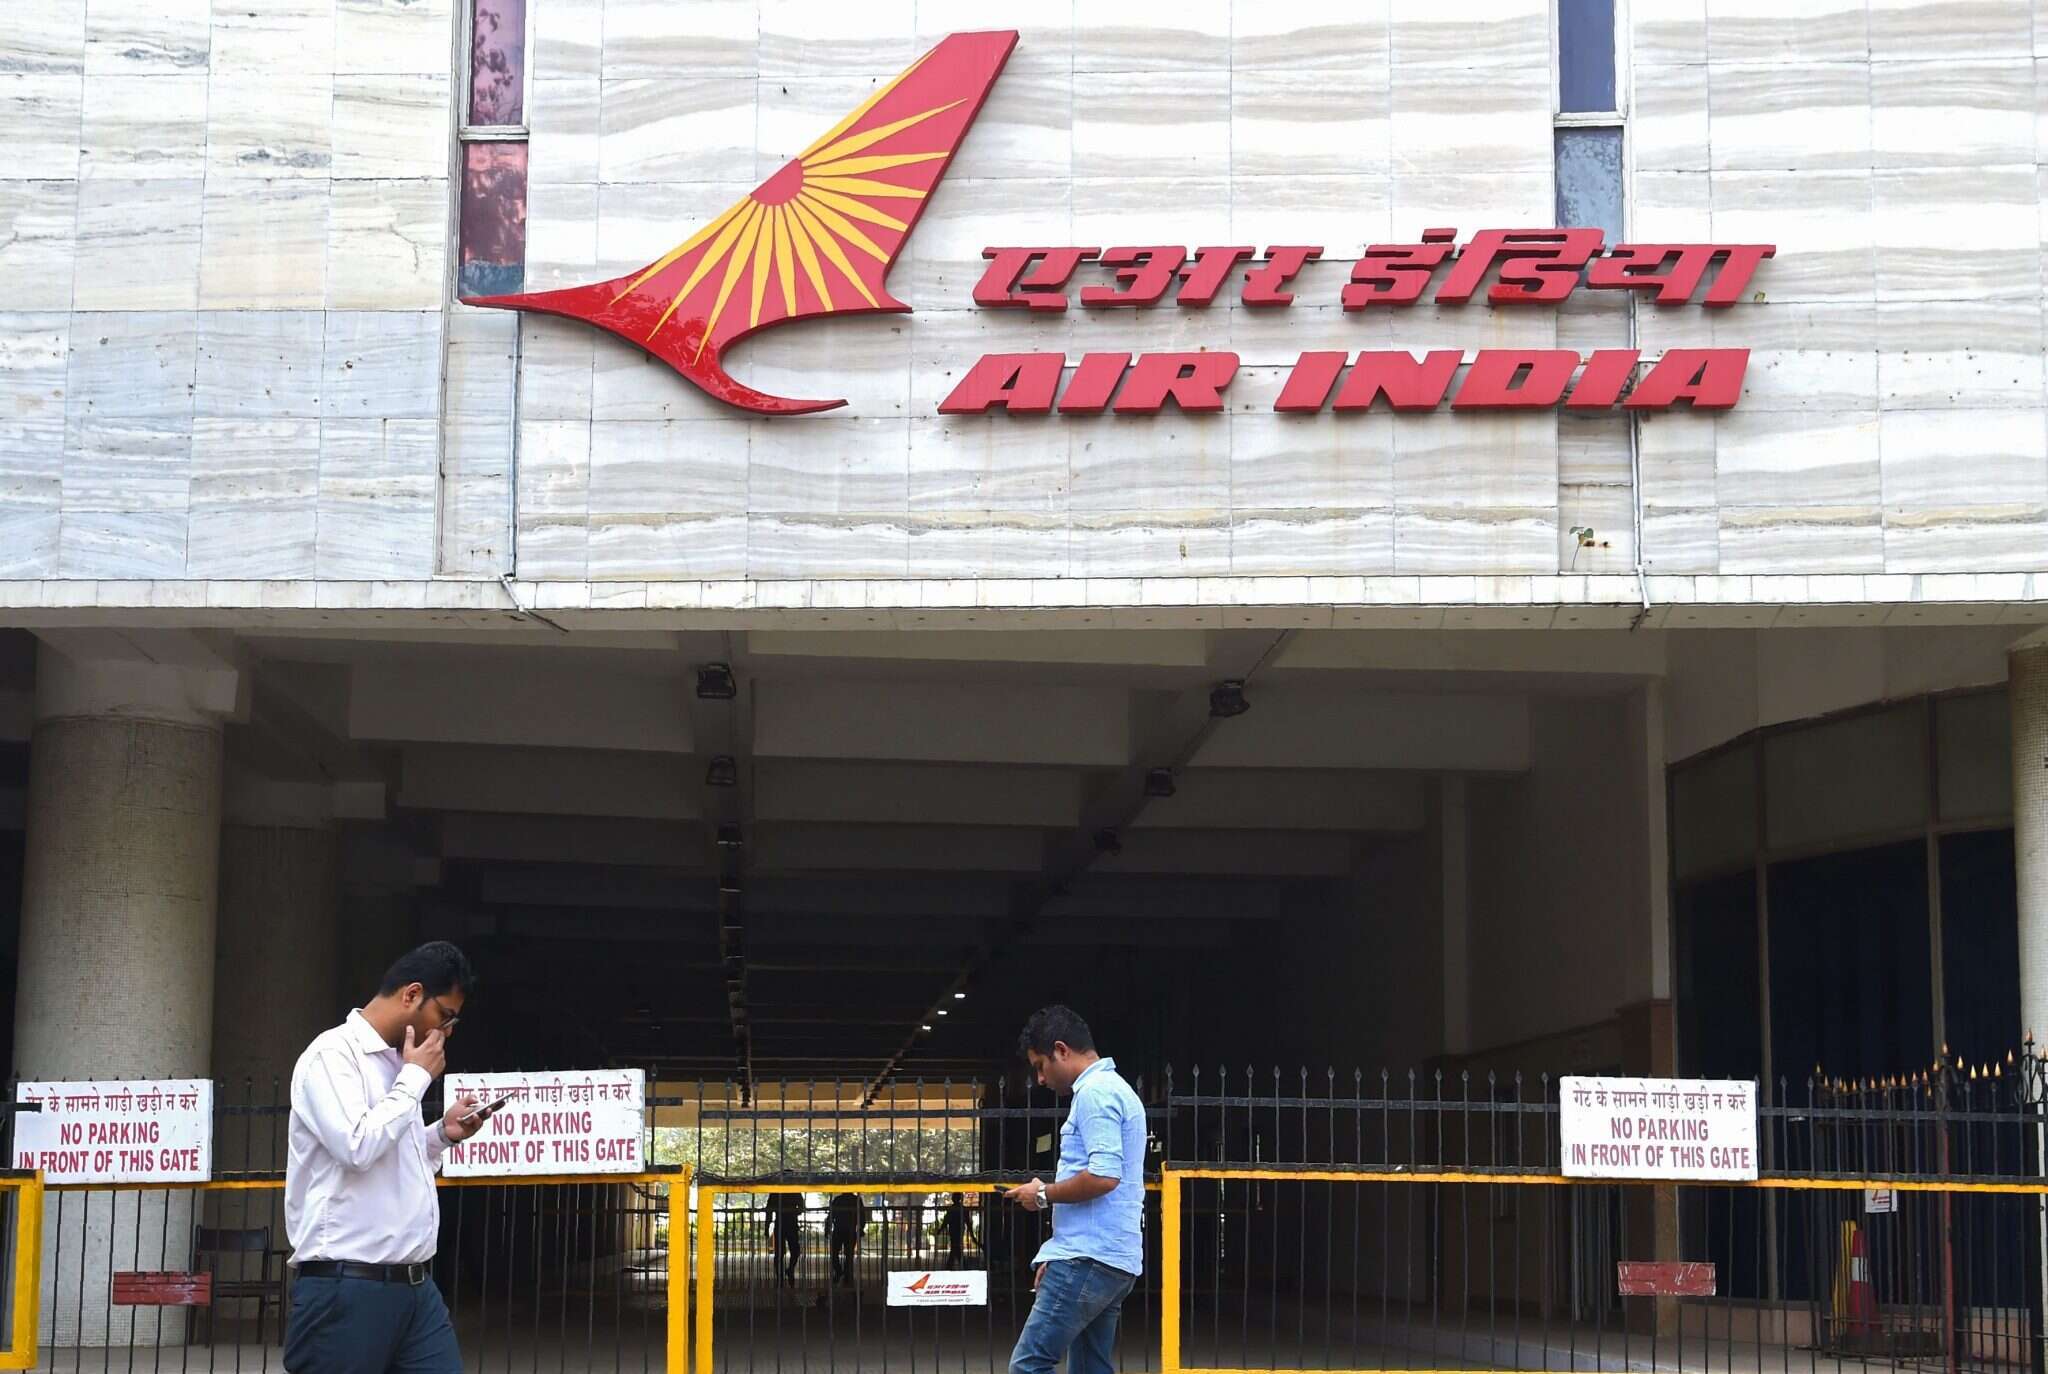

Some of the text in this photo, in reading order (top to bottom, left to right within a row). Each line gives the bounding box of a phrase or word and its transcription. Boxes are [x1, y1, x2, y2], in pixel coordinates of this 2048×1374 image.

[973, 228, 1776, 314] एअर इंडिया
[938, 348, 1751, 416] AIR INDIA
[48, 1087, 61, 1112] के
[64, 1086, 100, 1113] सामने
[104, 1086, 133, 1116] गाड़ी
[136, 1086, 162, 1115] खड़ी
[165, 1094, 176, 1111] न
[179, 1084, 198, 1112] करें
[478, 1078, 491, 1104] के
[534, 1077, 563, 1107] गाड़ी
[568, 1076, 594, 1106] खड़ी
[598, 1084, 608, 1101] न
[611, 1075, 632, 1102] करें
[1573, 1081, 1746, 1114] गेट के सामने गाड़ी खड़ी न करें
[60, 1121, 160, 1145] NO PARKING
[492, 1111, 592, 1136] NO PARKING
[1611, 1117, 1709, 1141] NO PARKING
[19, 1148, 199, 1173] IN FRONT OF THIS GATE
[449, 1138, 635, 1165] IN FRONT OF THIS GATE
[1571, 1143, 1750, 1169] IN FRONT OF THIS GATE
